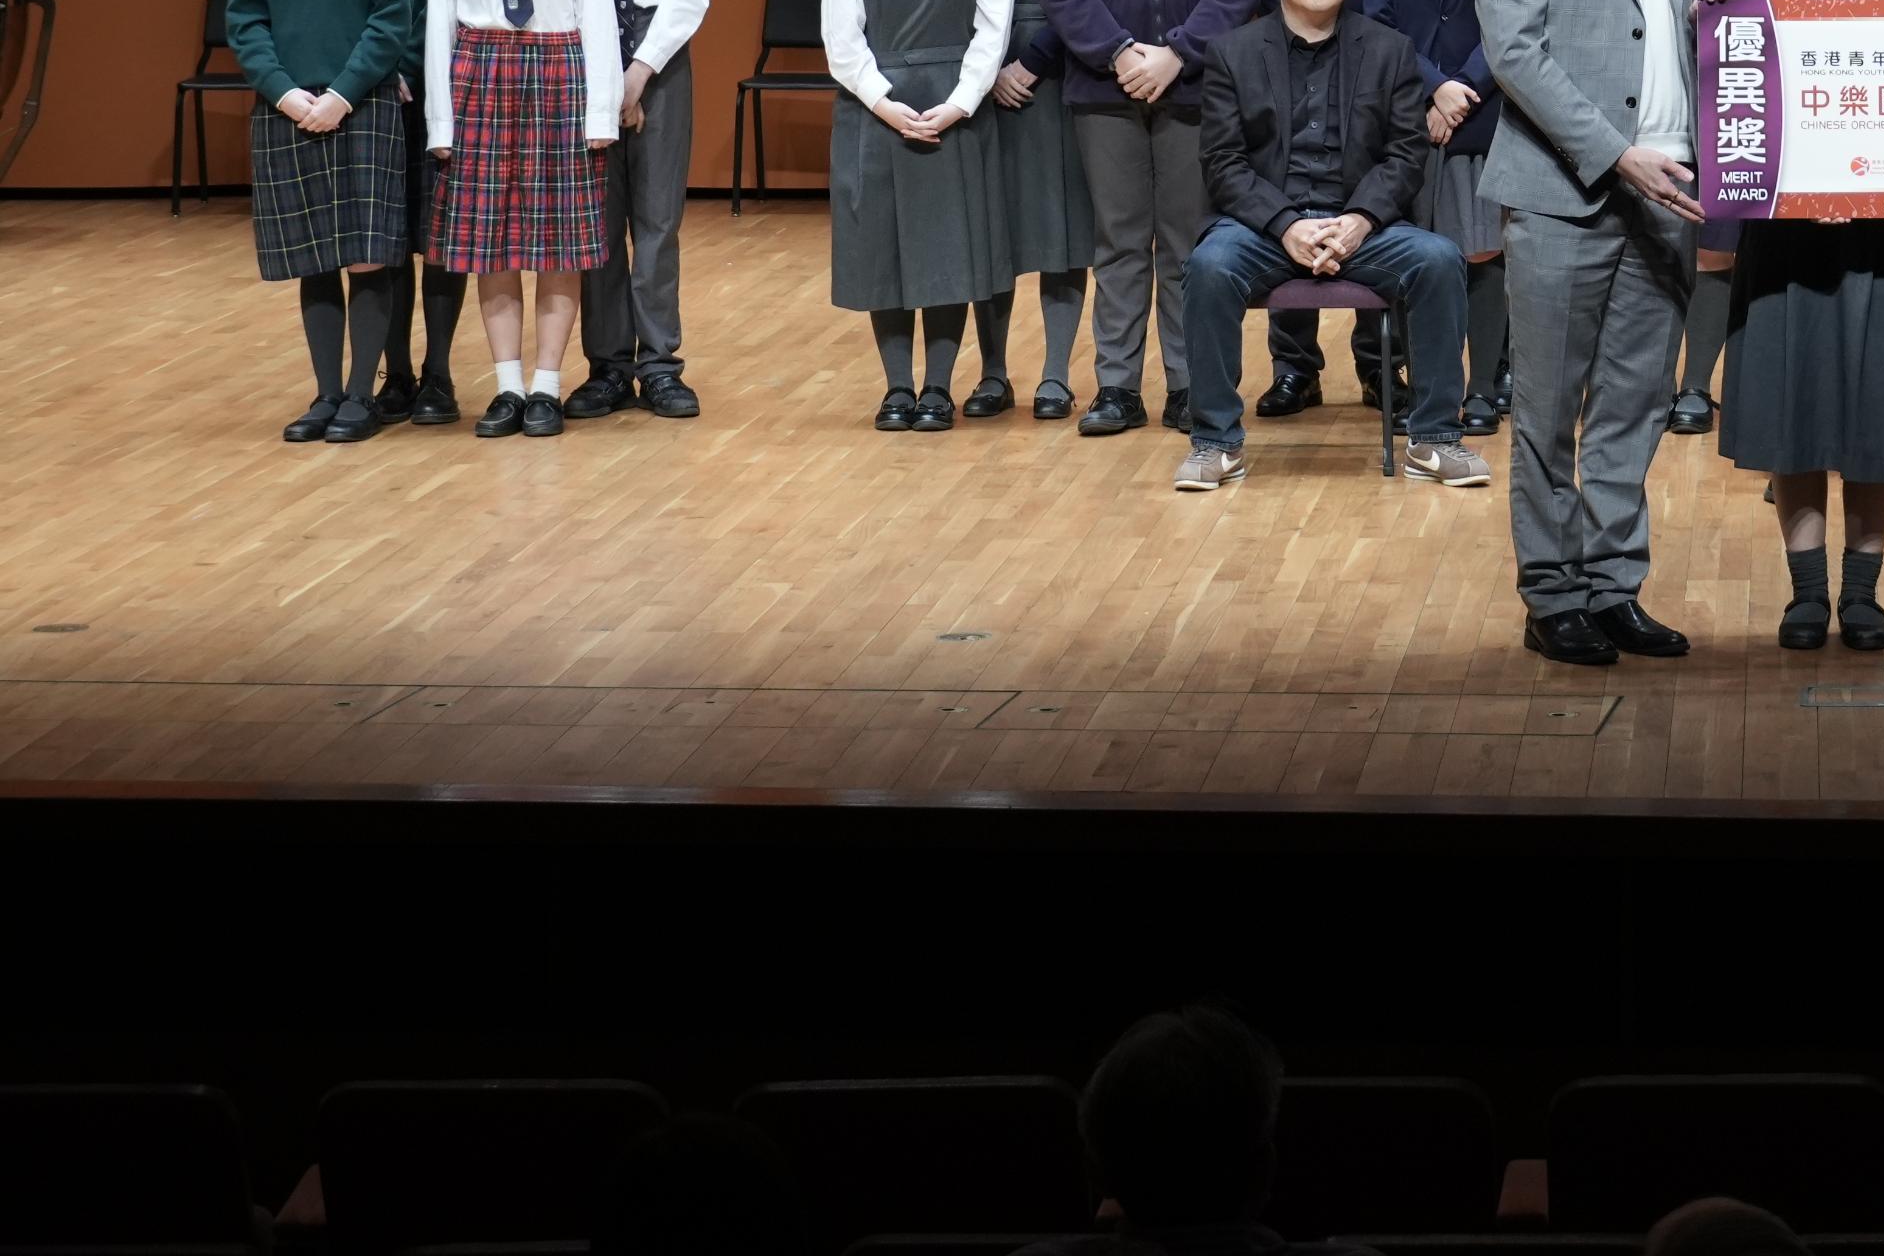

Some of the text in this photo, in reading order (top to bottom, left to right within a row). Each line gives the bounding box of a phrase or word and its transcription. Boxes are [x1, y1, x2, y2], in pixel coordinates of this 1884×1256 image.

[1714, 15, 1767, 164] 優異獎
[1800, 120, 1847, 130] CHINESE
[1721, 171, 1764, 184] MERIT
[1717, 188, 1768, 201] AWARD
